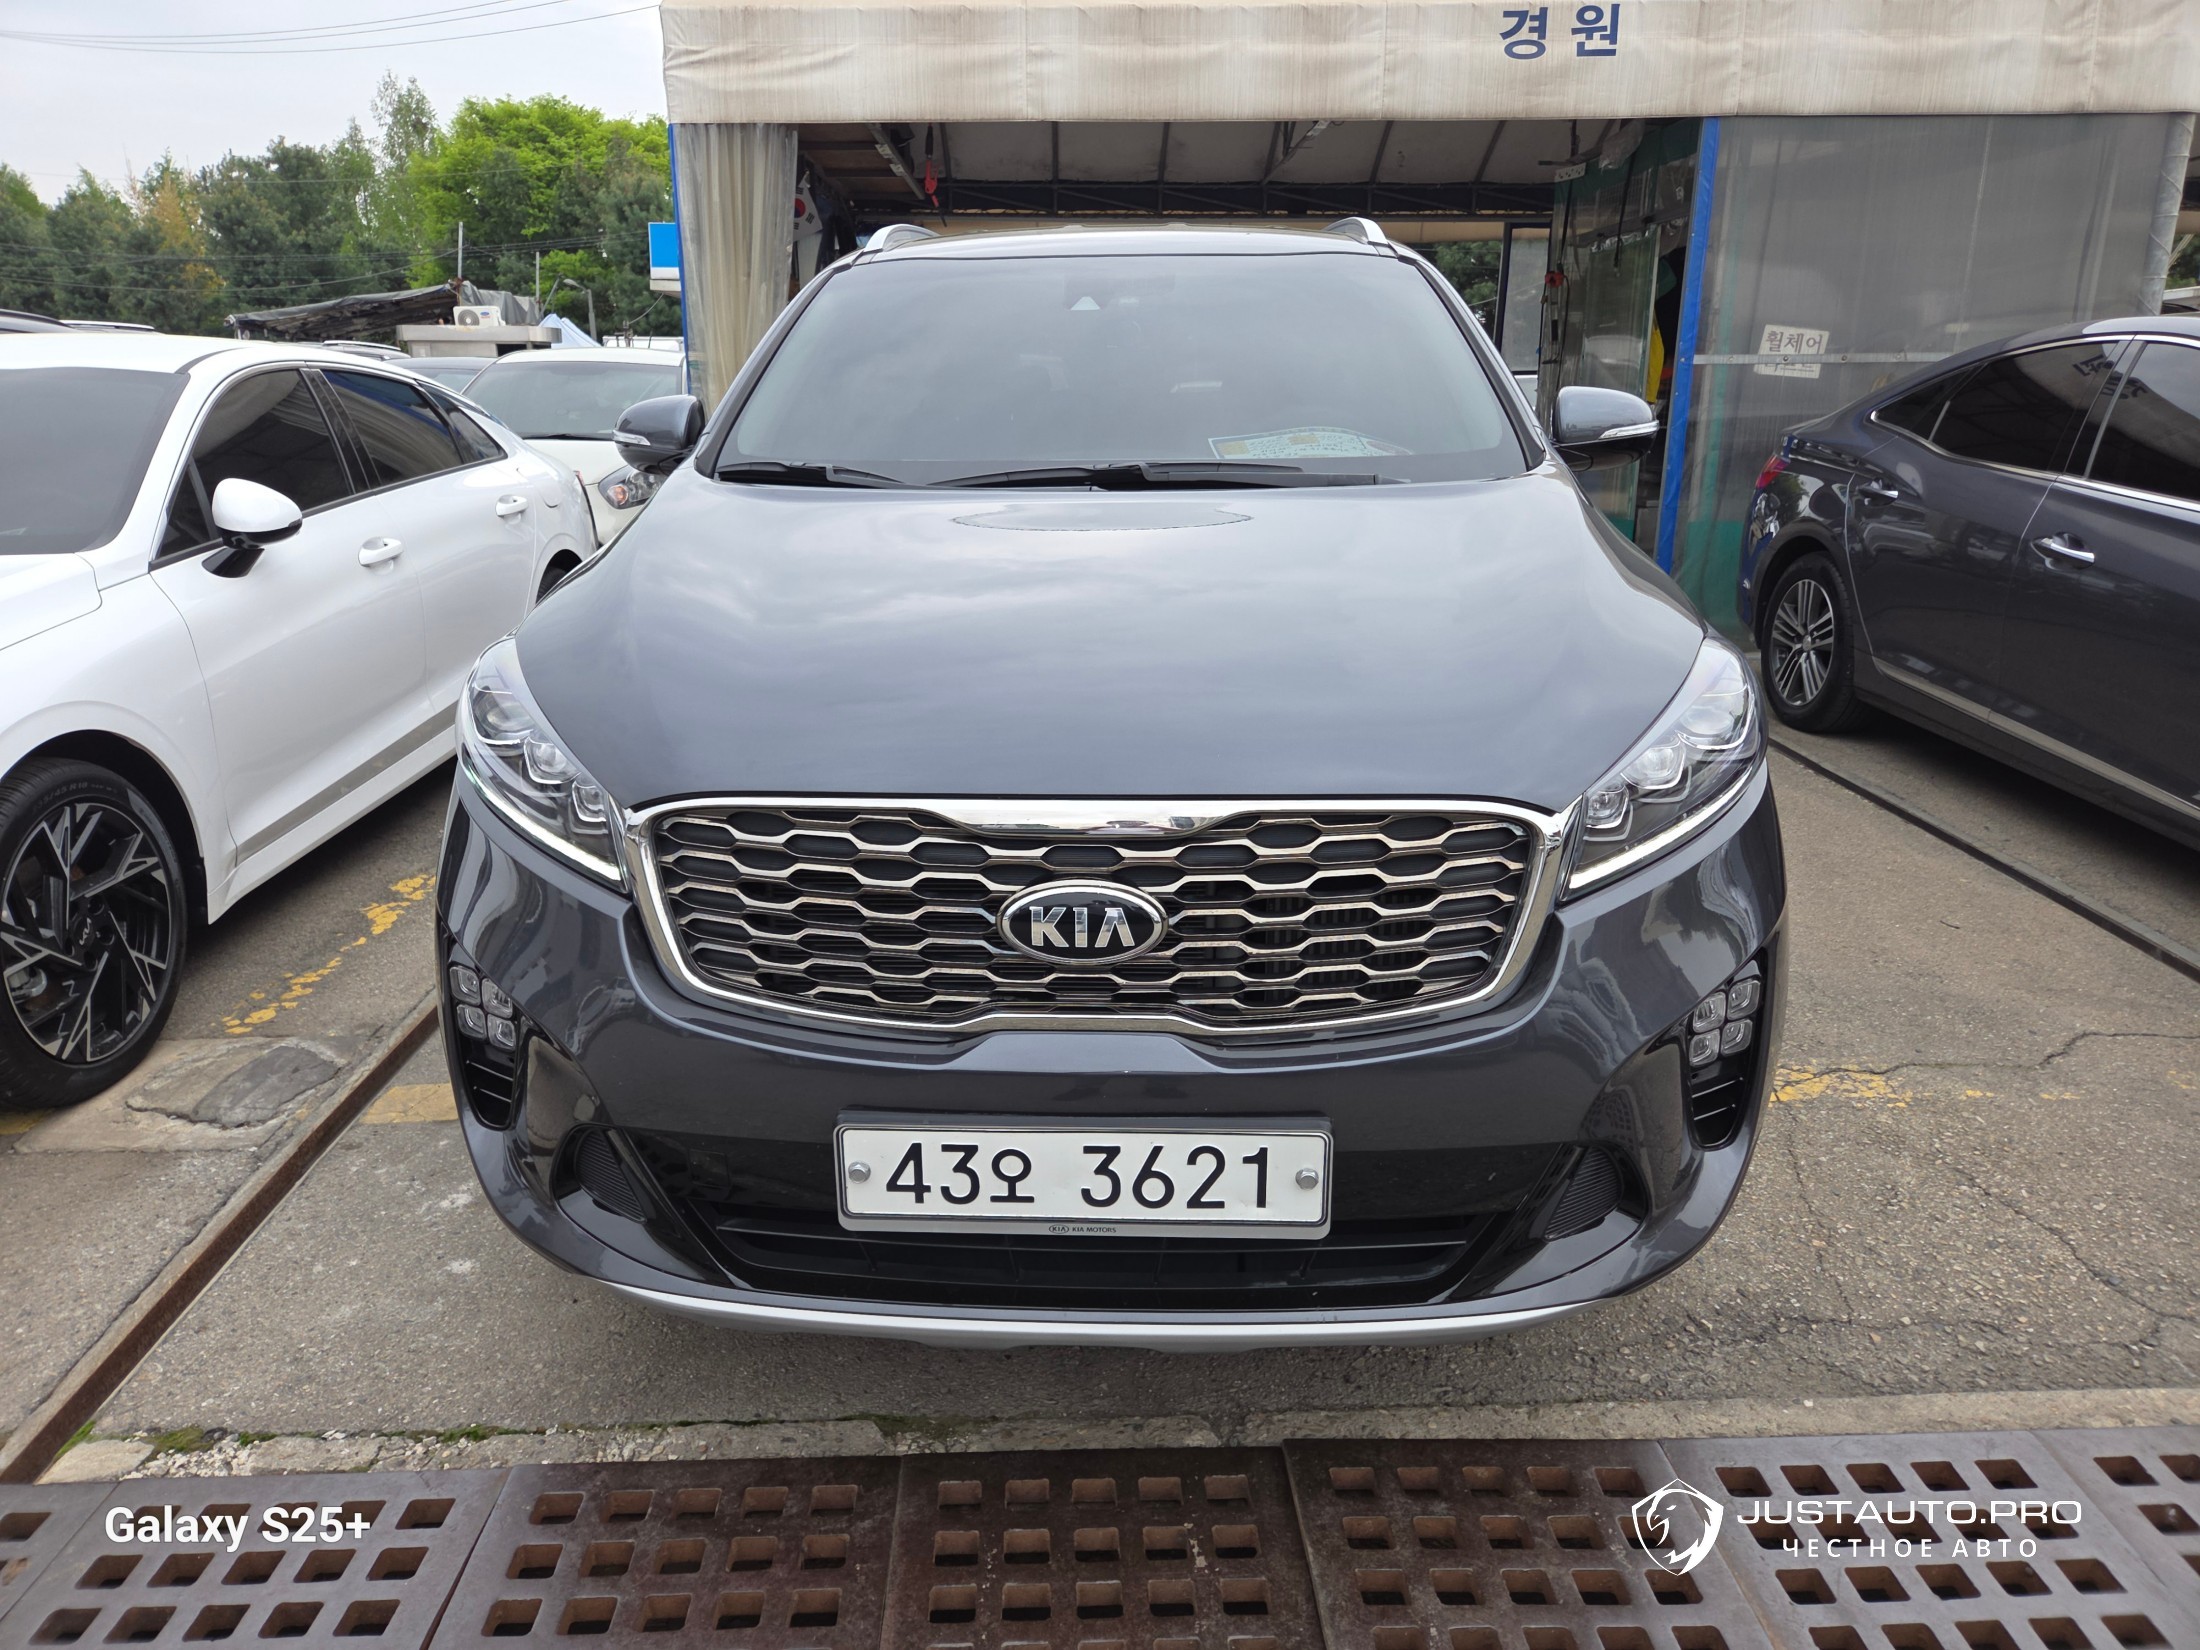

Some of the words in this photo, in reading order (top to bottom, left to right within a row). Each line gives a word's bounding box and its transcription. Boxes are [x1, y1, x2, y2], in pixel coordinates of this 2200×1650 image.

[1765, 330, 1823, 354] 휠체어
[1029, 906, 1135, 948] KIA
[886, 1142, 1035, 1205] 43오
[1080, 1145, 1270, 1209] 3621
